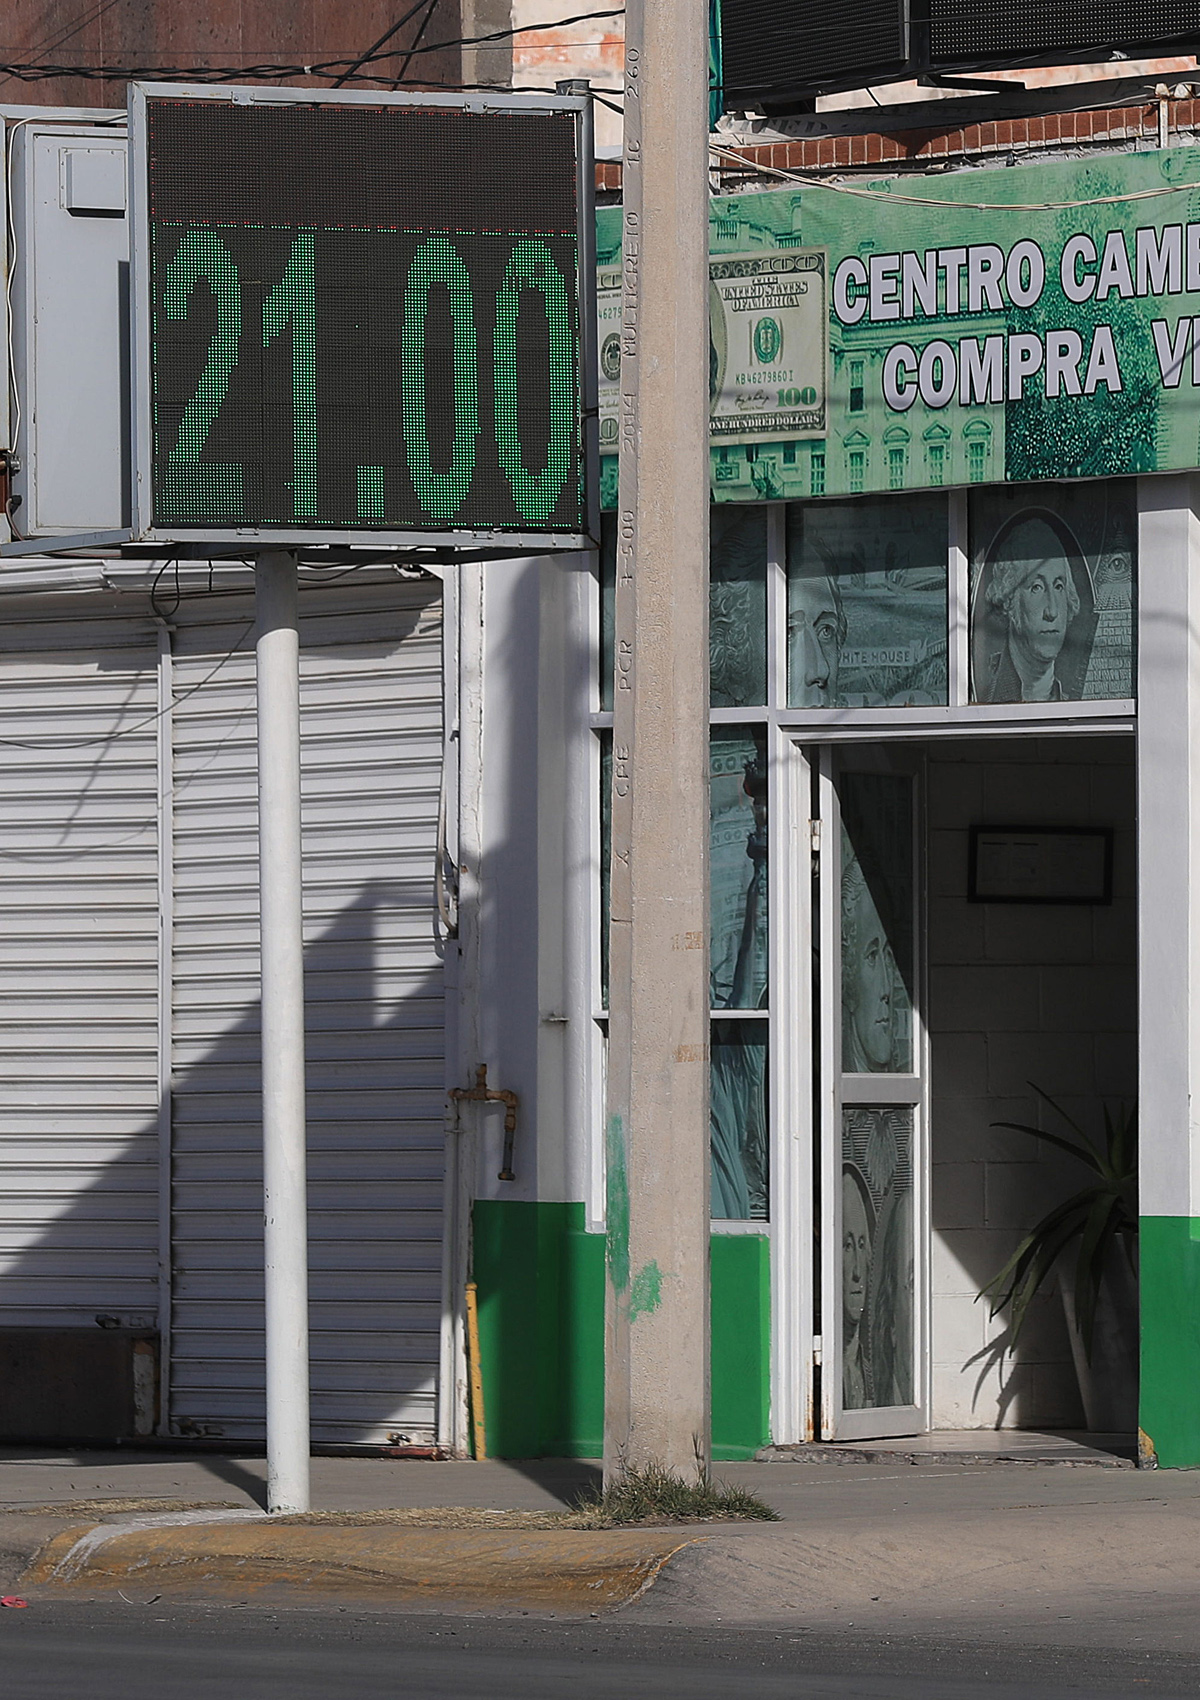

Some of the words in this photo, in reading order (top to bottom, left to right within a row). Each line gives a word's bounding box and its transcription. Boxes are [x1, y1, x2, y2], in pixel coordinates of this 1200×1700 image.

[626, 48, 641, 99] 260
[721, 284, 764, 301] UNITED
[763, 280, 810, 297] STATES
[732, 298, 748, 312] OF
[746, 294, 800, 311] AMERICA
[833, 238, 1046, 325] CENTRO
[161, 229, 575, 520] 21.00
[882, 324, 1126, 412] COMPRA
[729, 416, 775, 430] HUNDRED
[776, 413, 820, 425] DOLLARS
[776, 386, 817, 407] 100
[622, 392, 637, 453] 2014
[618, 639, 633, 692] PCR
[840, 651, 868, 664] HITE
[871, 650, 911, 664] HOUSE
